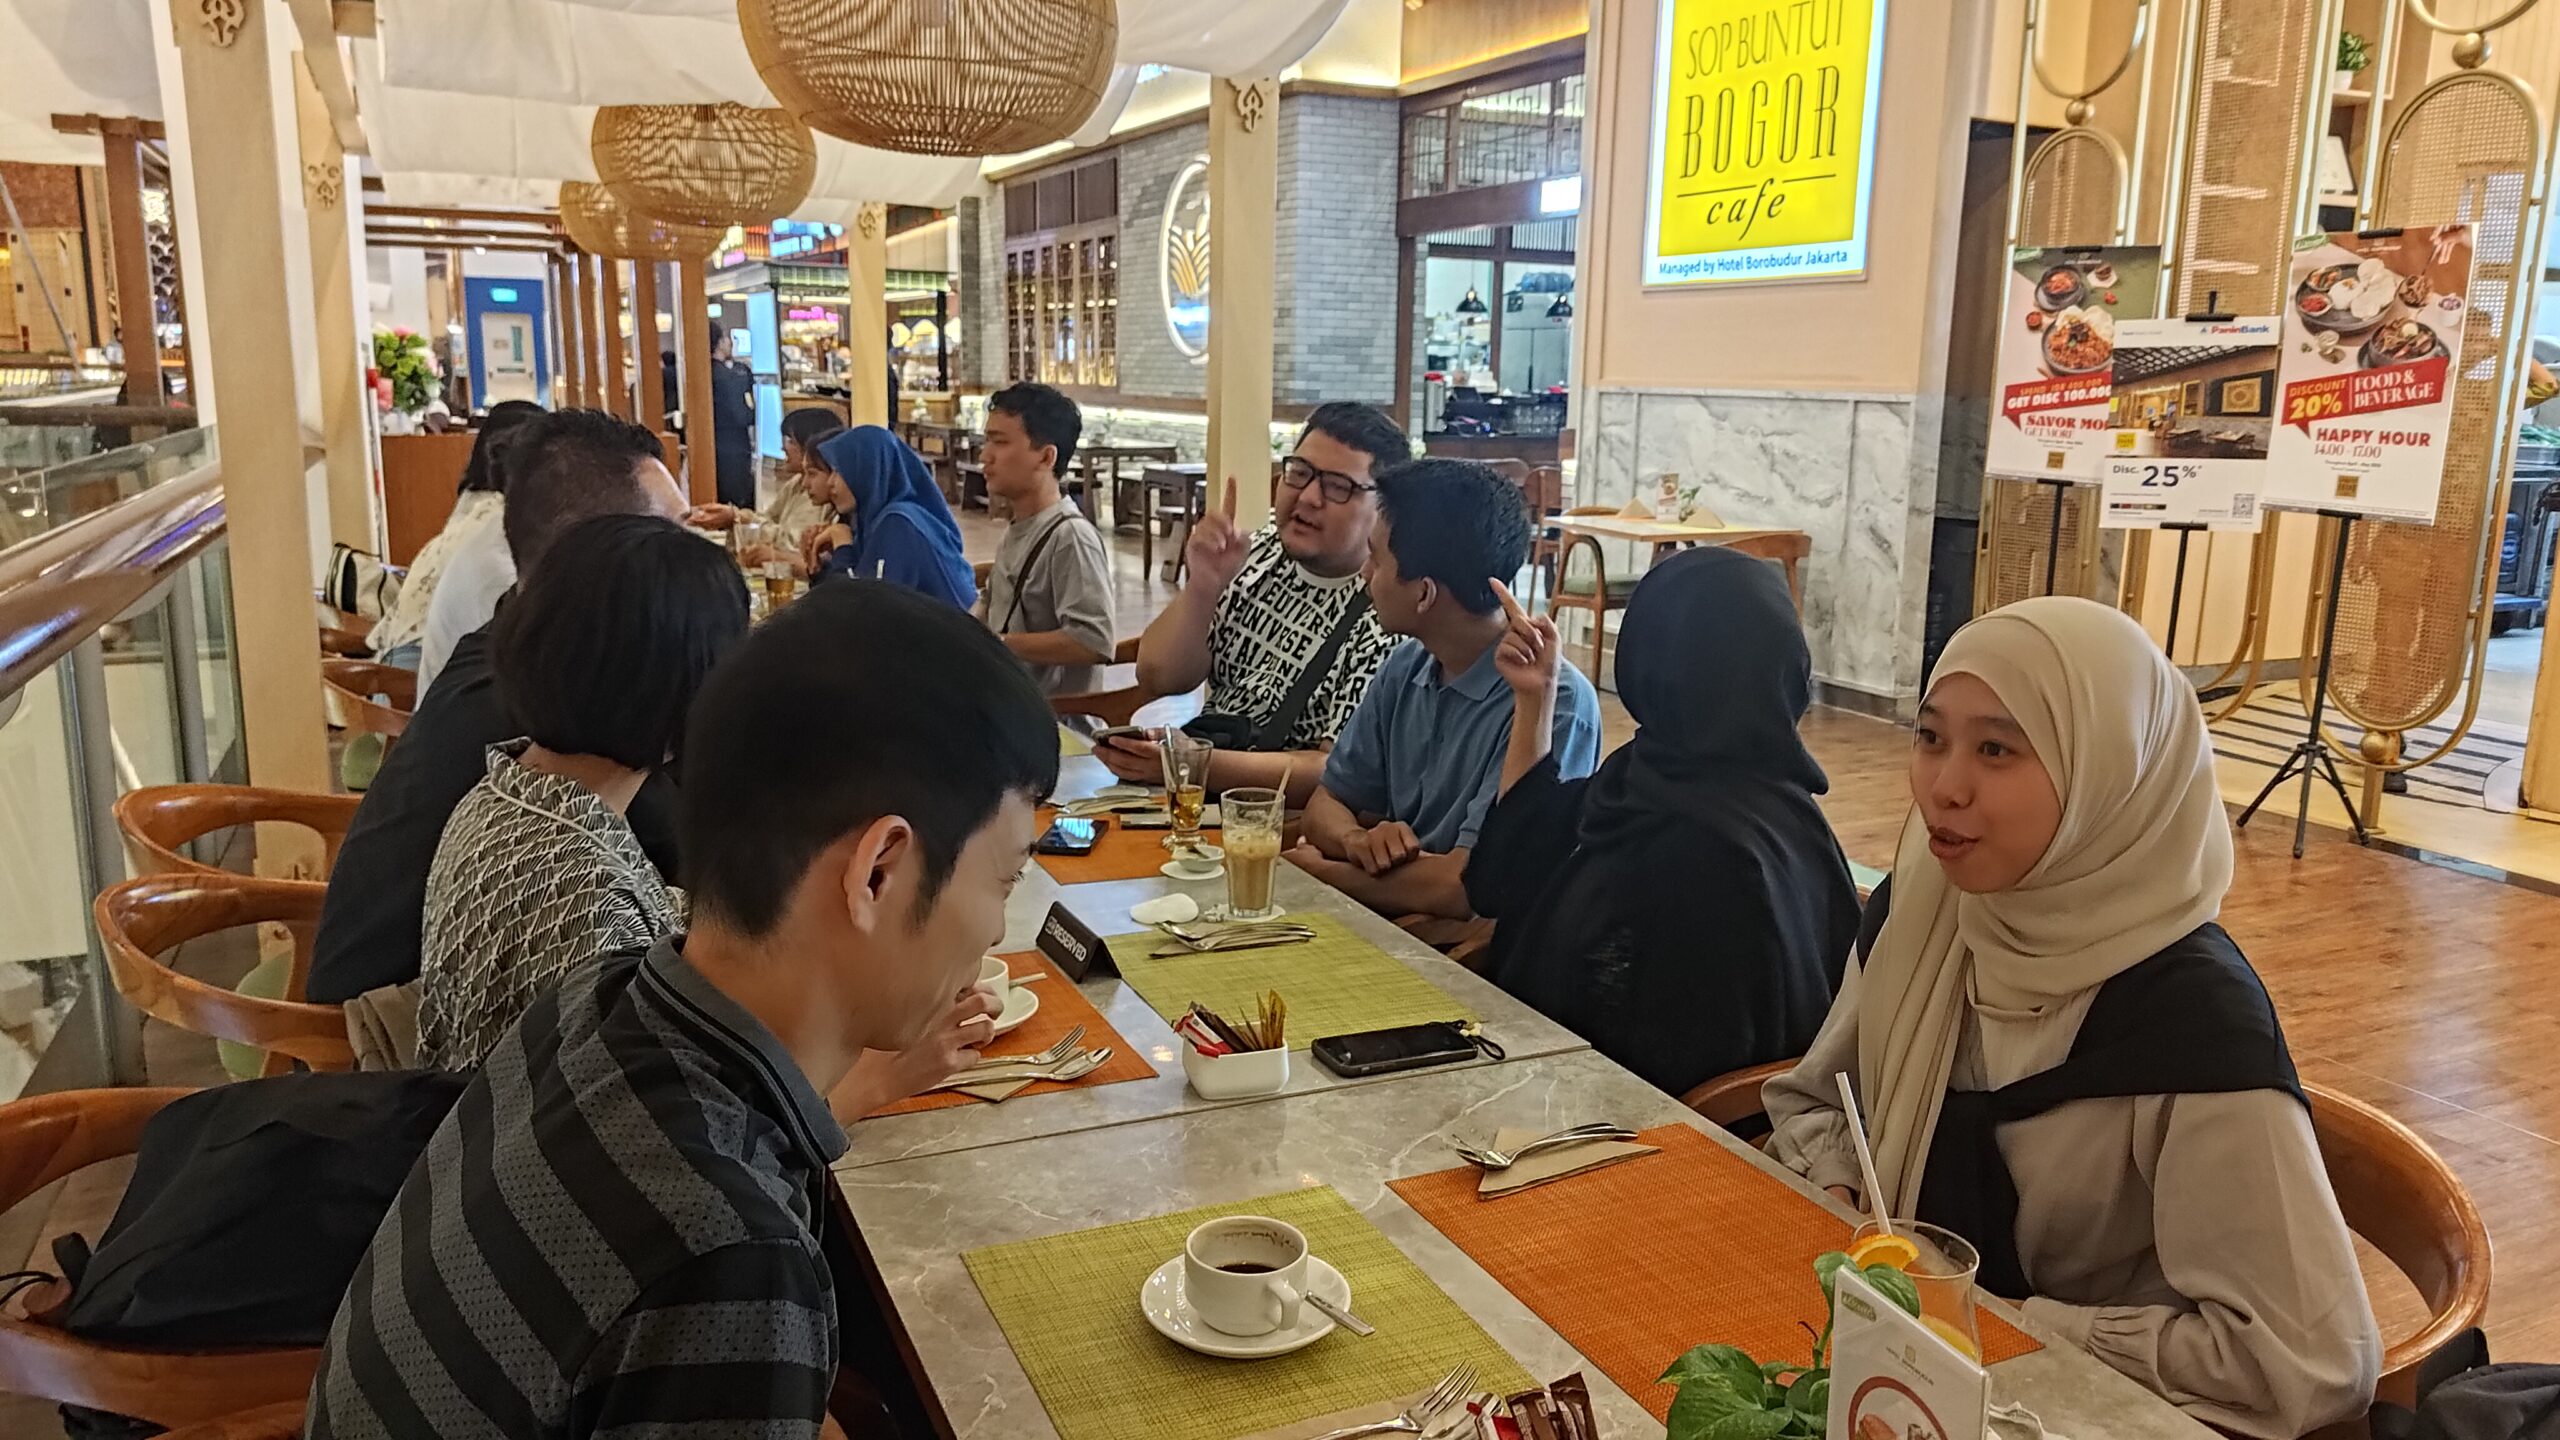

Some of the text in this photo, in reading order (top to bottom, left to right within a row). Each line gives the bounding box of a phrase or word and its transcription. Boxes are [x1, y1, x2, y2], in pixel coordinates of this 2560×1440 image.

[1686, 22, 1732, 79] SOP
[1680, 66, 1840, 179] BOGOR
[1706, 178, 1786, 241] cafe
[1659, 250, 1847, 277] Managed by Hotel Borobudur Jakarta
[2211, 324, 2270, 335] PaninBank
[2288, 378, 2347, 398] DISCOUNT
[2354, 369, 2416, 392] FOOD &
[2007, 396, 2031, 410] GET
[2032, 392, 2060, 407] DISC
[2289, 391, 2343, 420] 20%
[2354, 382, 2434, 408] BEVERAGE
[2024, 427, 2043, 437] GET
[2026, 414, 2077, 429] SAVOR
[2316, 427, 2431, 447] HAPPY HOUR
[2112, 465, 2139, 474] Disc.
[1053, 923, 1087, 962] RESERVED
